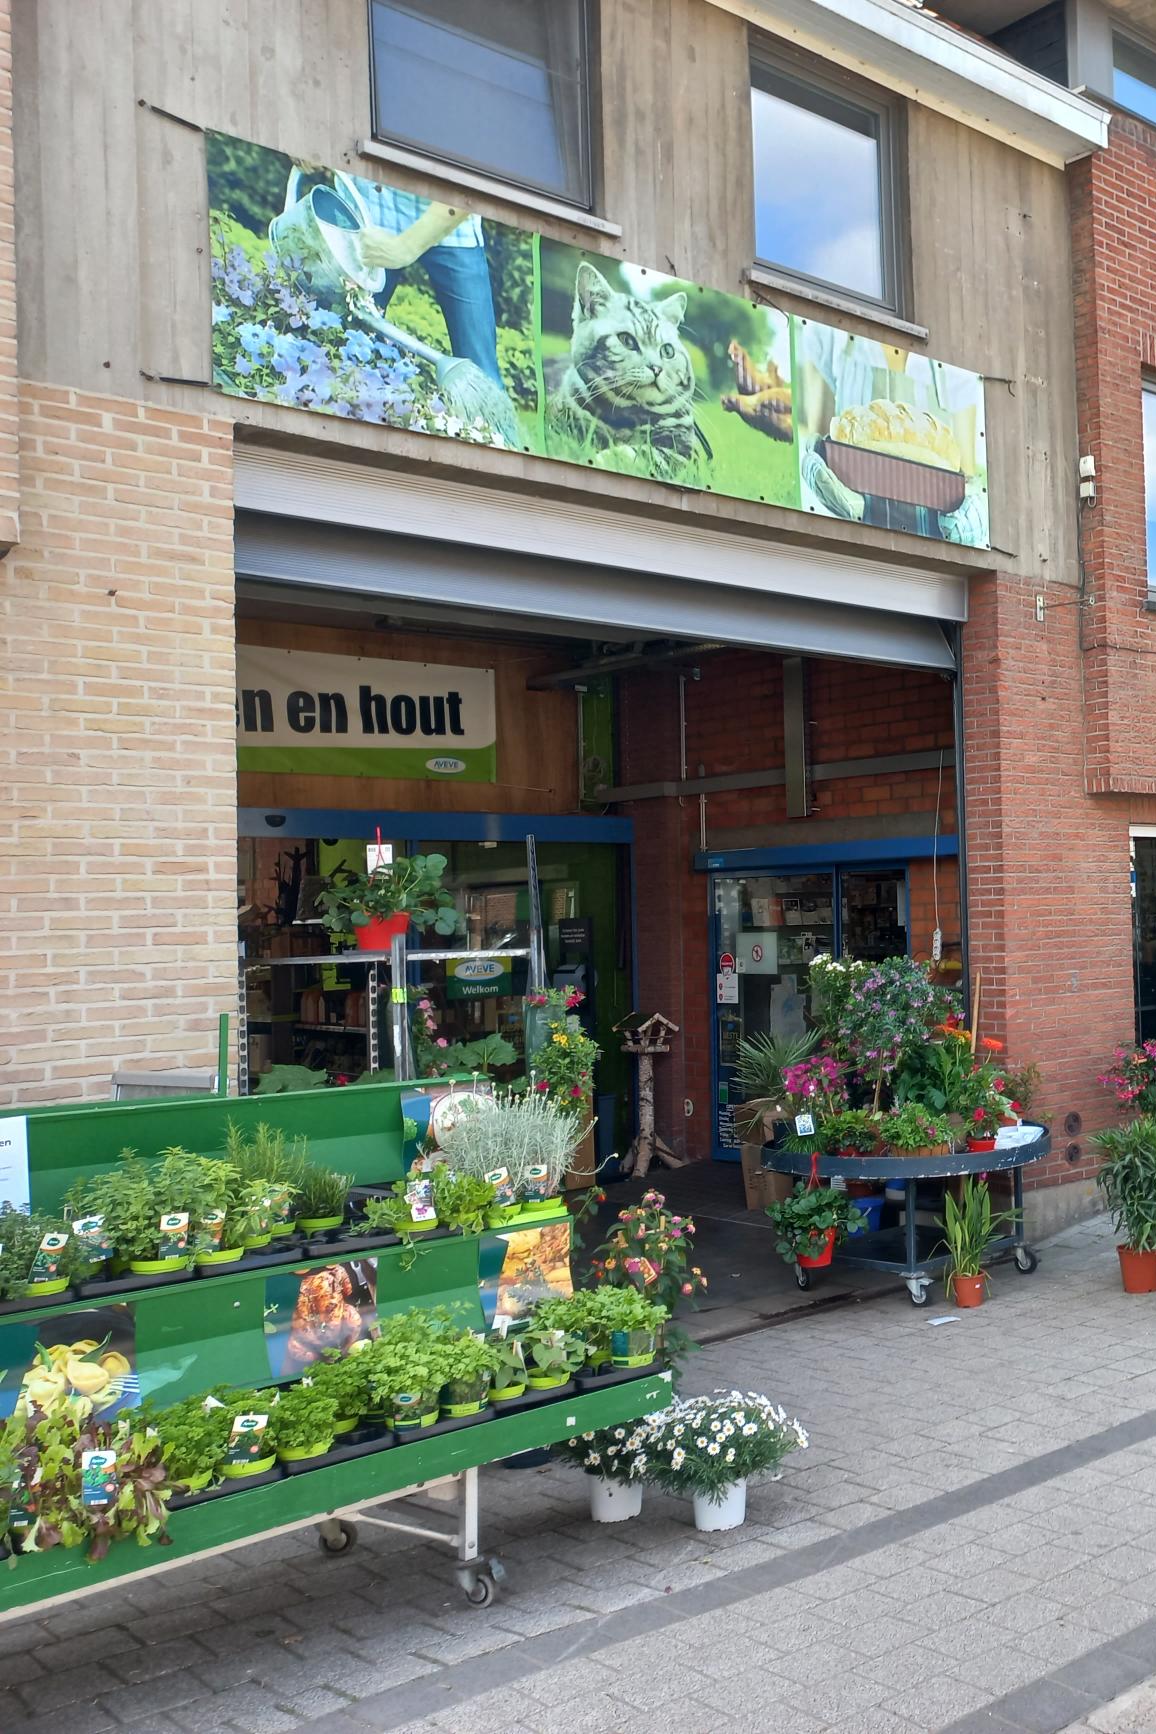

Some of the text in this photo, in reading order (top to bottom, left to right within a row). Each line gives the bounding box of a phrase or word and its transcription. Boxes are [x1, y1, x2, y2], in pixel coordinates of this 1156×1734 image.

[286, 690, 349, 734] en
[359, 685, 465, 736] hout
[433, 760, 459, 769] AVEVE
[464, 963, 496, 976] AVEVE
[462, 984, 499, 995] Welkom
